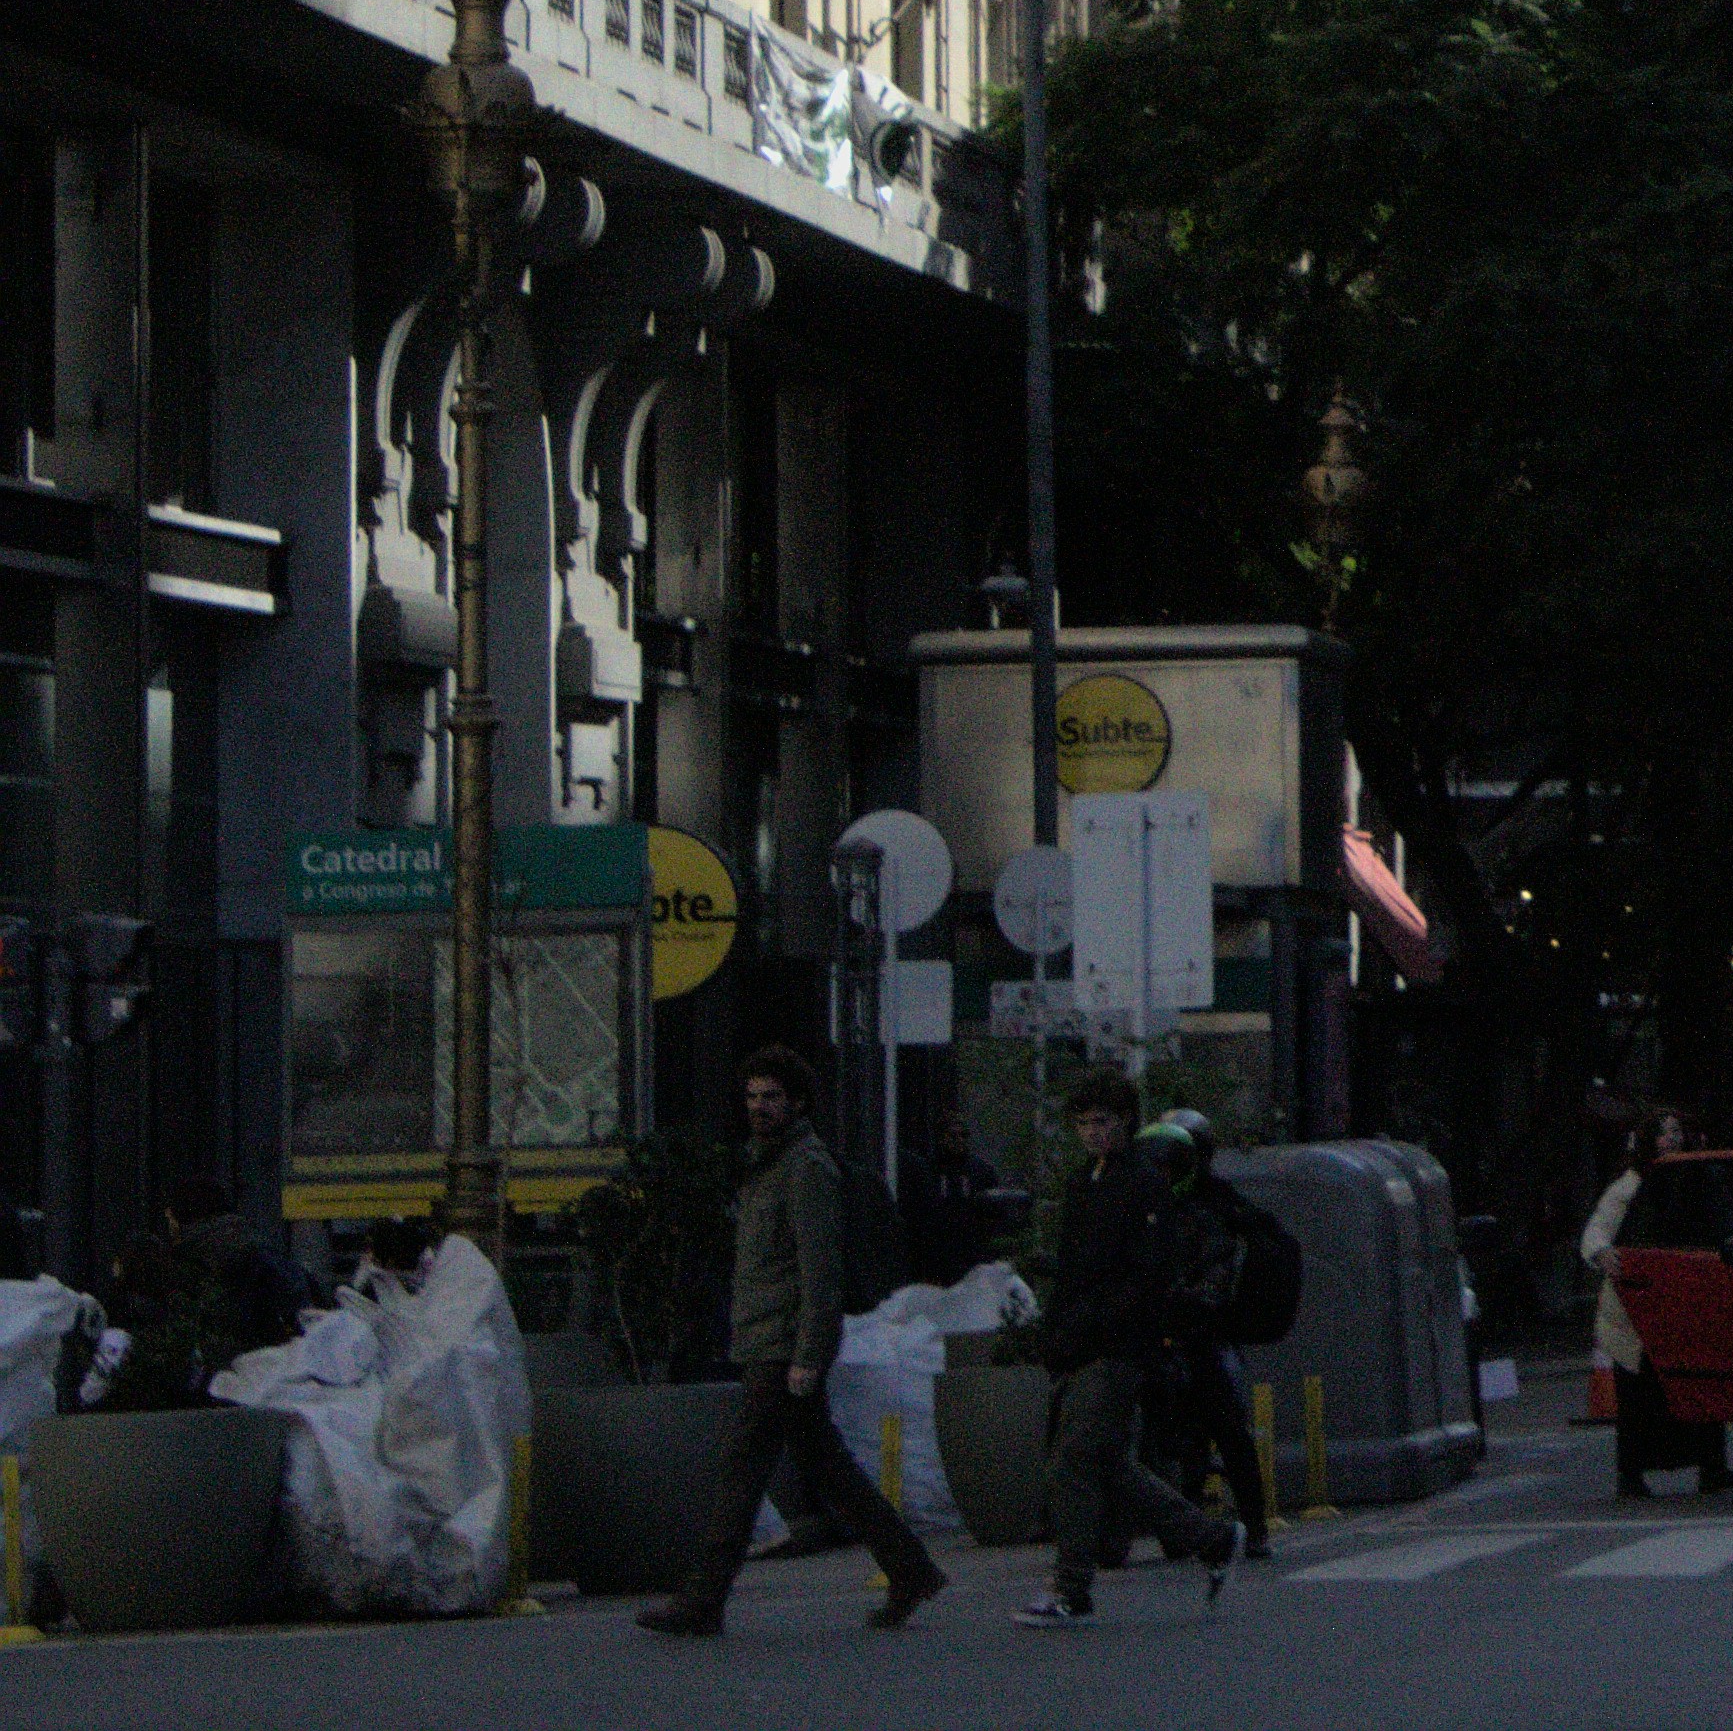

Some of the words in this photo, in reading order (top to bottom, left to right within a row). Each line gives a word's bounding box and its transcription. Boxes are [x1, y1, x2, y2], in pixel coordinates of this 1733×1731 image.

[1056, 715, 1152, 745] Subte
[301, 840, 442, 875] Catedral
[318, 880, 408, 902] Congreso
[652, 890, 713, 922] bte
